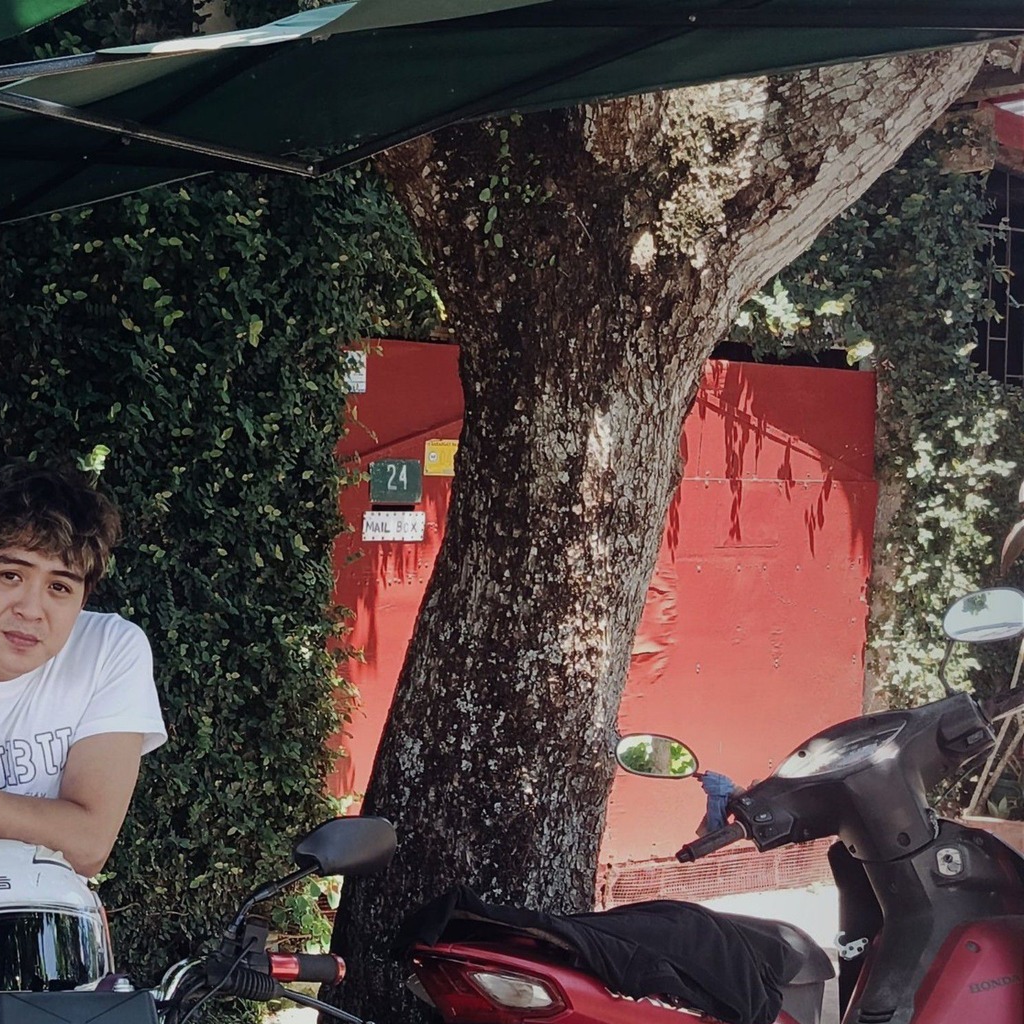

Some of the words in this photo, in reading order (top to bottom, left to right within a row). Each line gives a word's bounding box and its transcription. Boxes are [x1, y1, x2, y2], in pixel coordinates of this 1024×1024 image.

[387, 464, 407, 491] 24
[365, 520, 391, 533] MAIL
[395, 520, 418, 533] BOX
[968, 973, 1021, 995] HONDA
